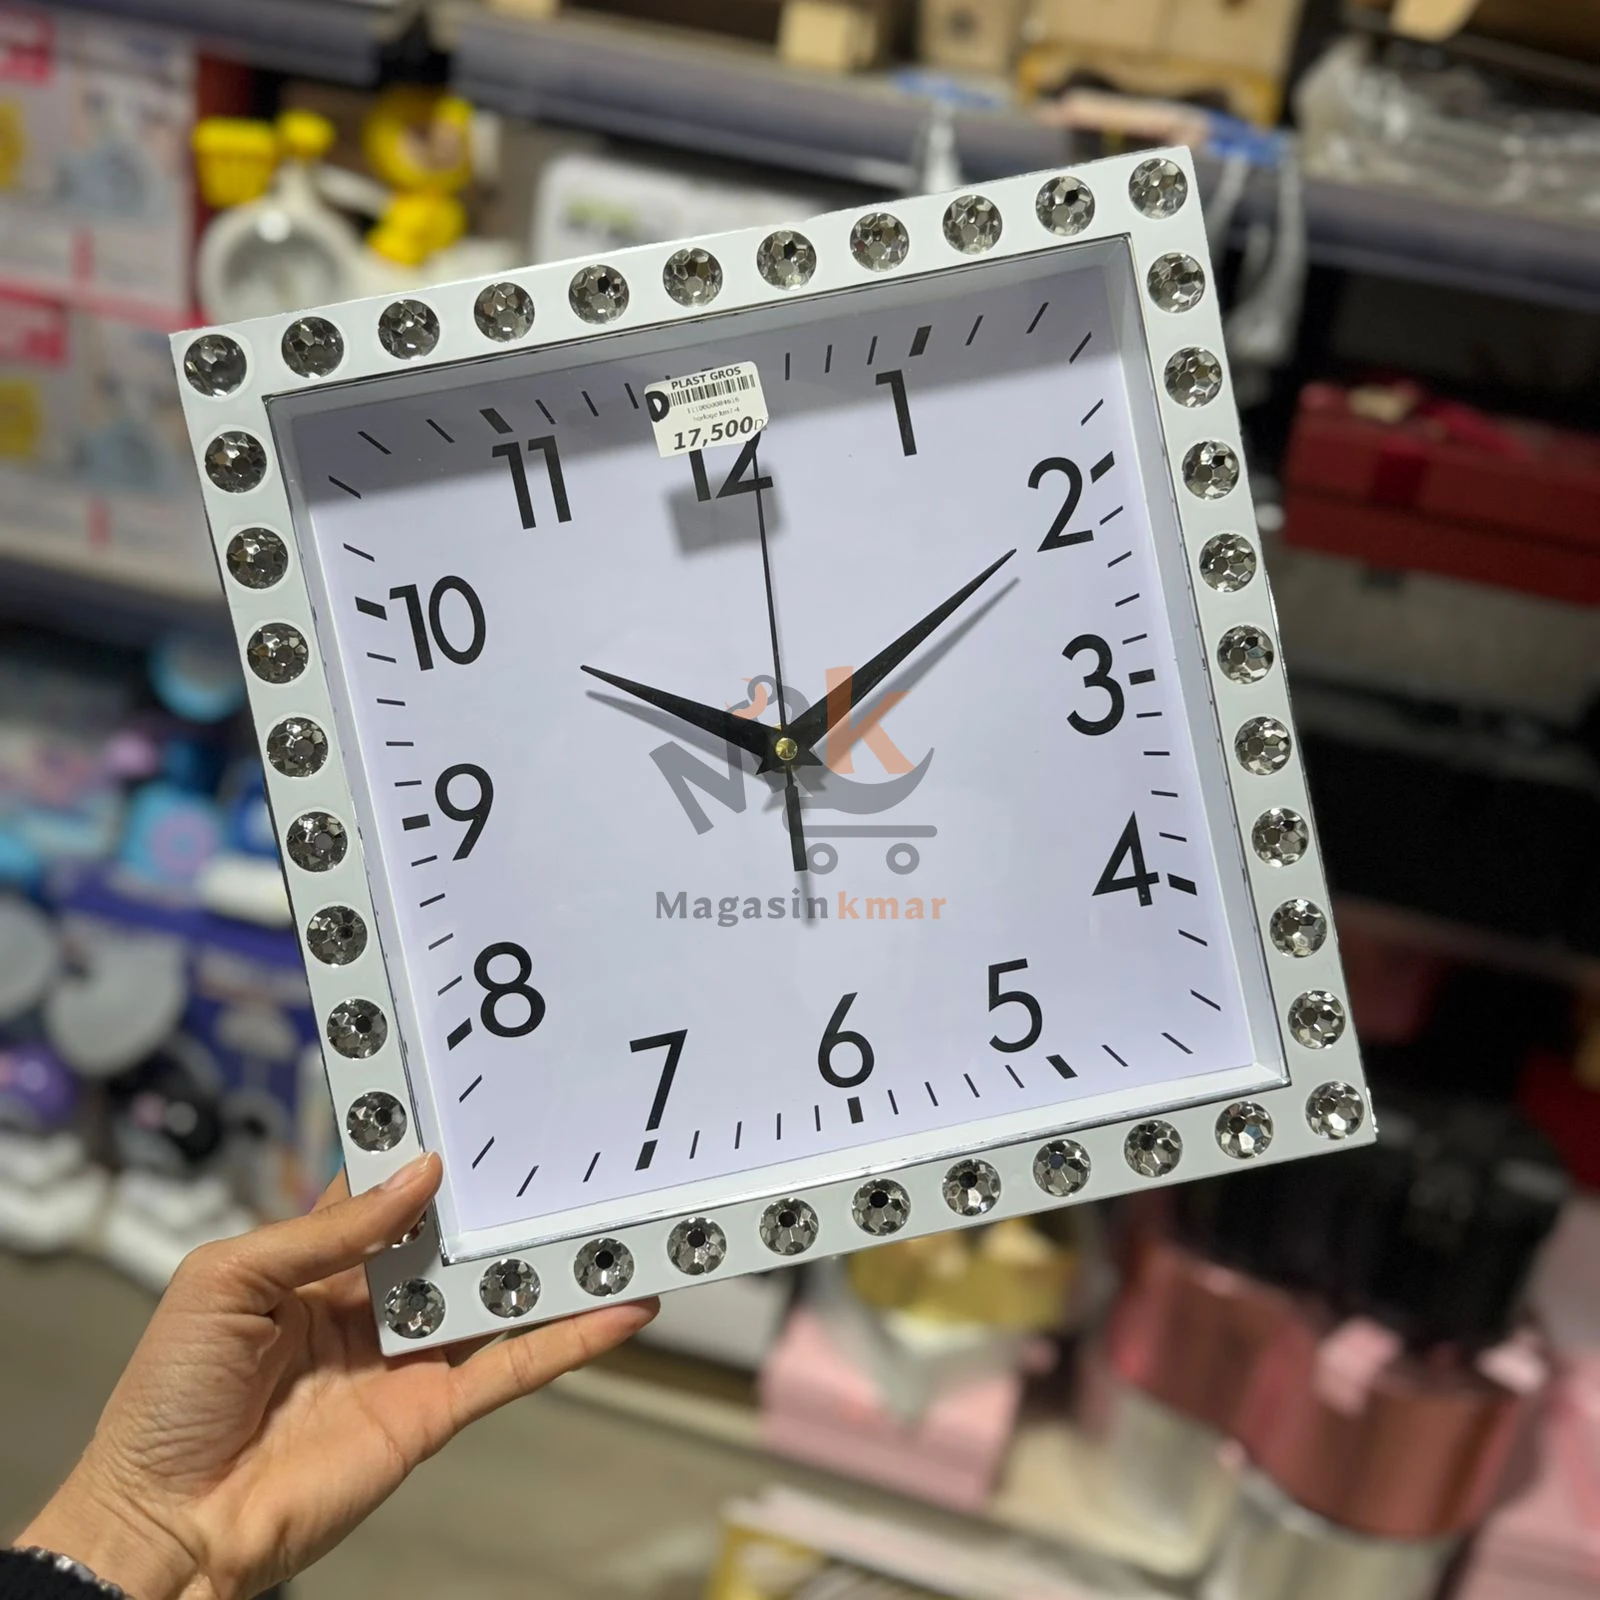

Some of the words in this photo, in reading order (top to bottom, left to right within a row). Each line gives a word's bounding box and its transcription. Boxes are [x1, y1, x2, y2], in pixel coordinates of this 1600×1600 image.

[671, 374, 706, 390] PLAST
[710, 366, 742, 381] GROS
[876, 369, 916, 456] 1
[492, 435, 571, 529] 11
[1028, 458, 1093, 552] 2
[390, 576, 486, 671] 10
[1062, 634, 1125, 735] 3
[435, 764, 494, 860] 9
[1093, 812, 1159, 906] 4
[474, 942, 545, 1038] 8
[989, 959, 1043, 1052] 5
[630, 1030, 687, 1131] 7
[818, 993, 874, 1088] 6
